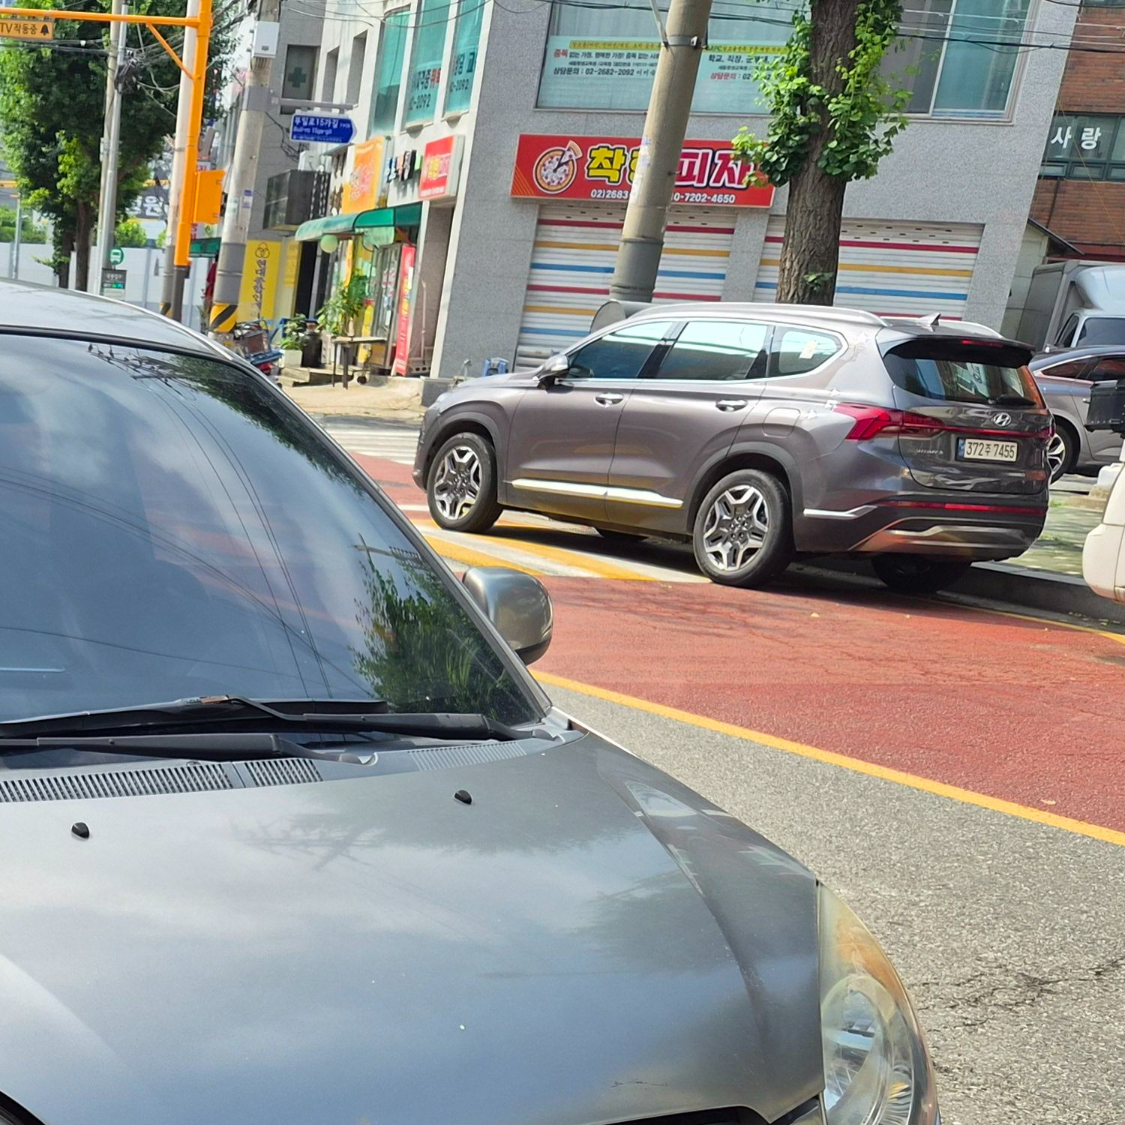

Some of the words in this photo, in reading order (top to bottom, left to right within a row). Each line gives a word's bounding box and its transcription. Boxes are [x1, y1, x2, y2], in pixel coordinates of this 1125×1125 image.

[553, 67, 580, 76] 상담문의
[585, 68, 635, 76] 02-2682-2092
[1050, 125, 1102, 150] 사랑
[966, 441, 992, 457] 372주
[993, 443, 1015, 459] 7455
